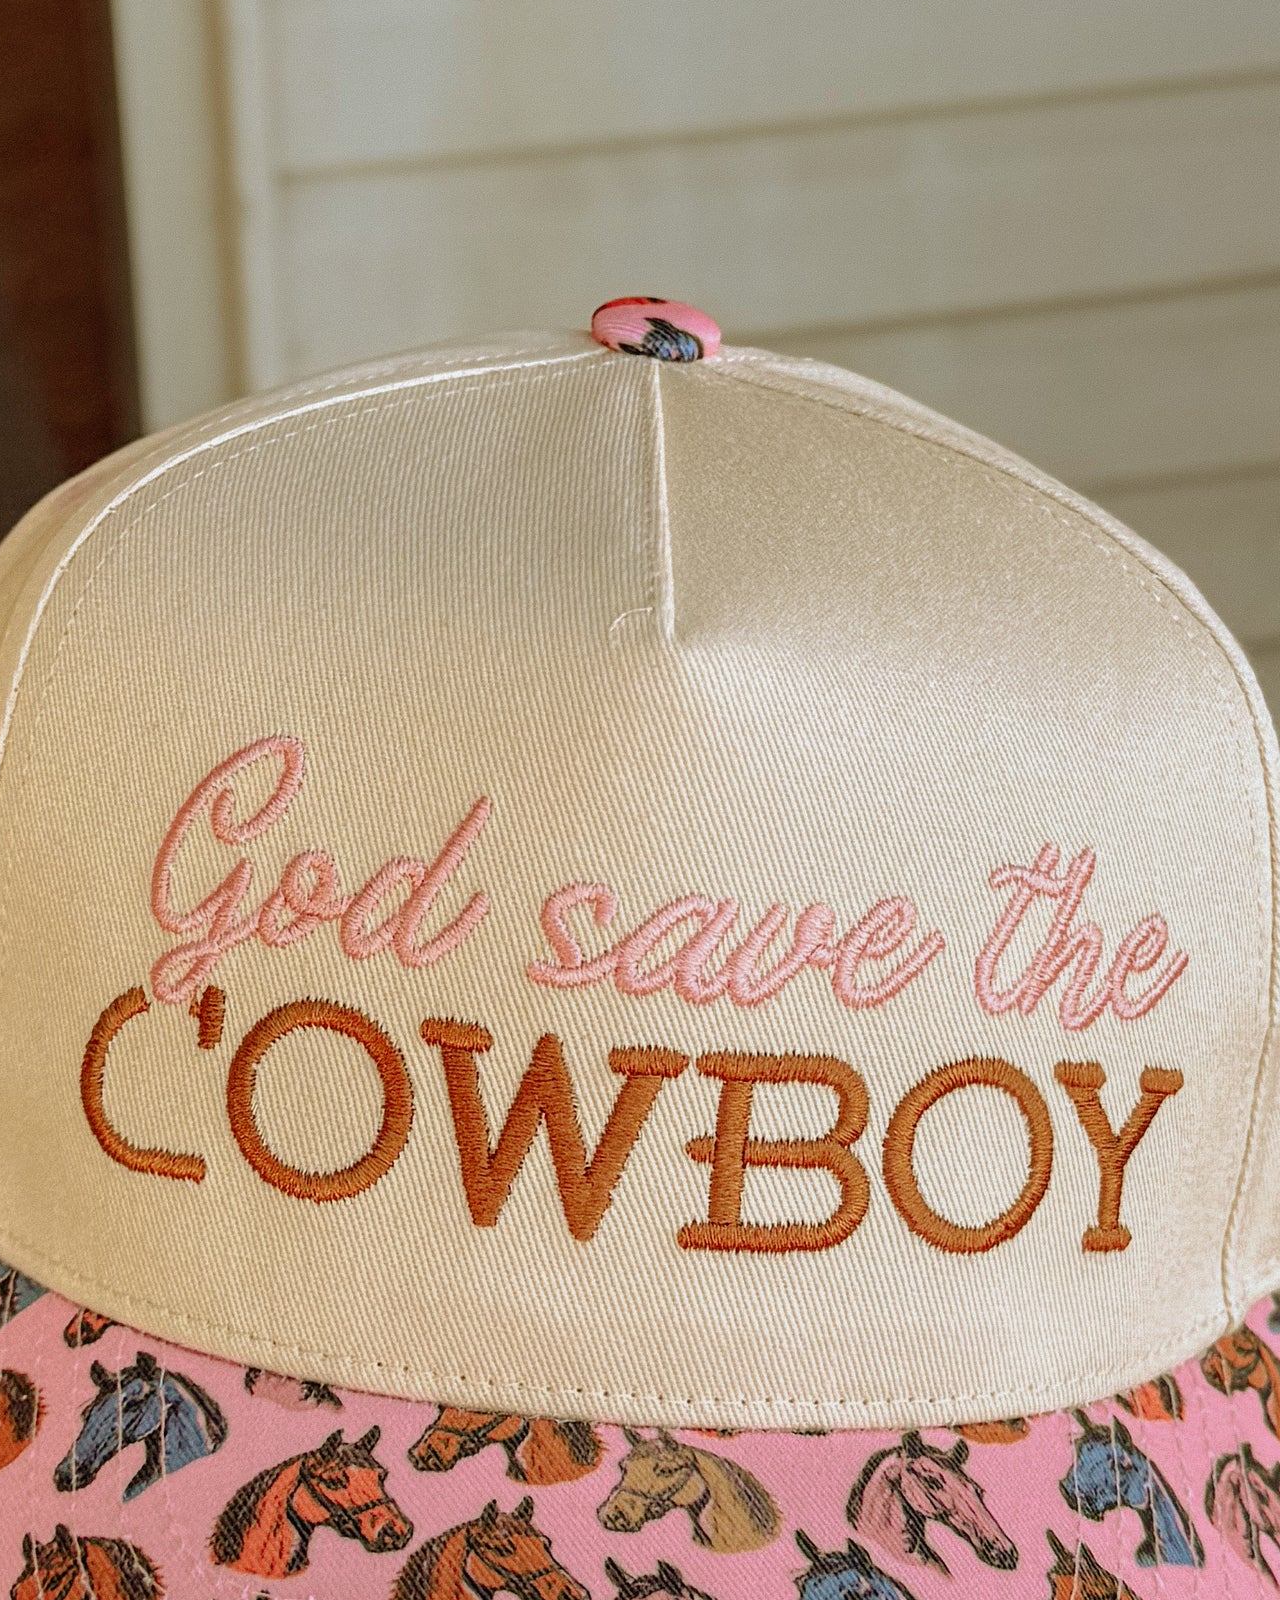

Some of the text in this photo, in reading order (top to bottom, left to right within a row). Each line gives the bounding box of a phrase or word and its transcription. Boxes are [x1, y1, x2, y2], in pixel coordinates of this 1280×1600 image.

[148, 734, 1190, 1031] God save the
[79, 986, 1186, 1255] COWBOY
